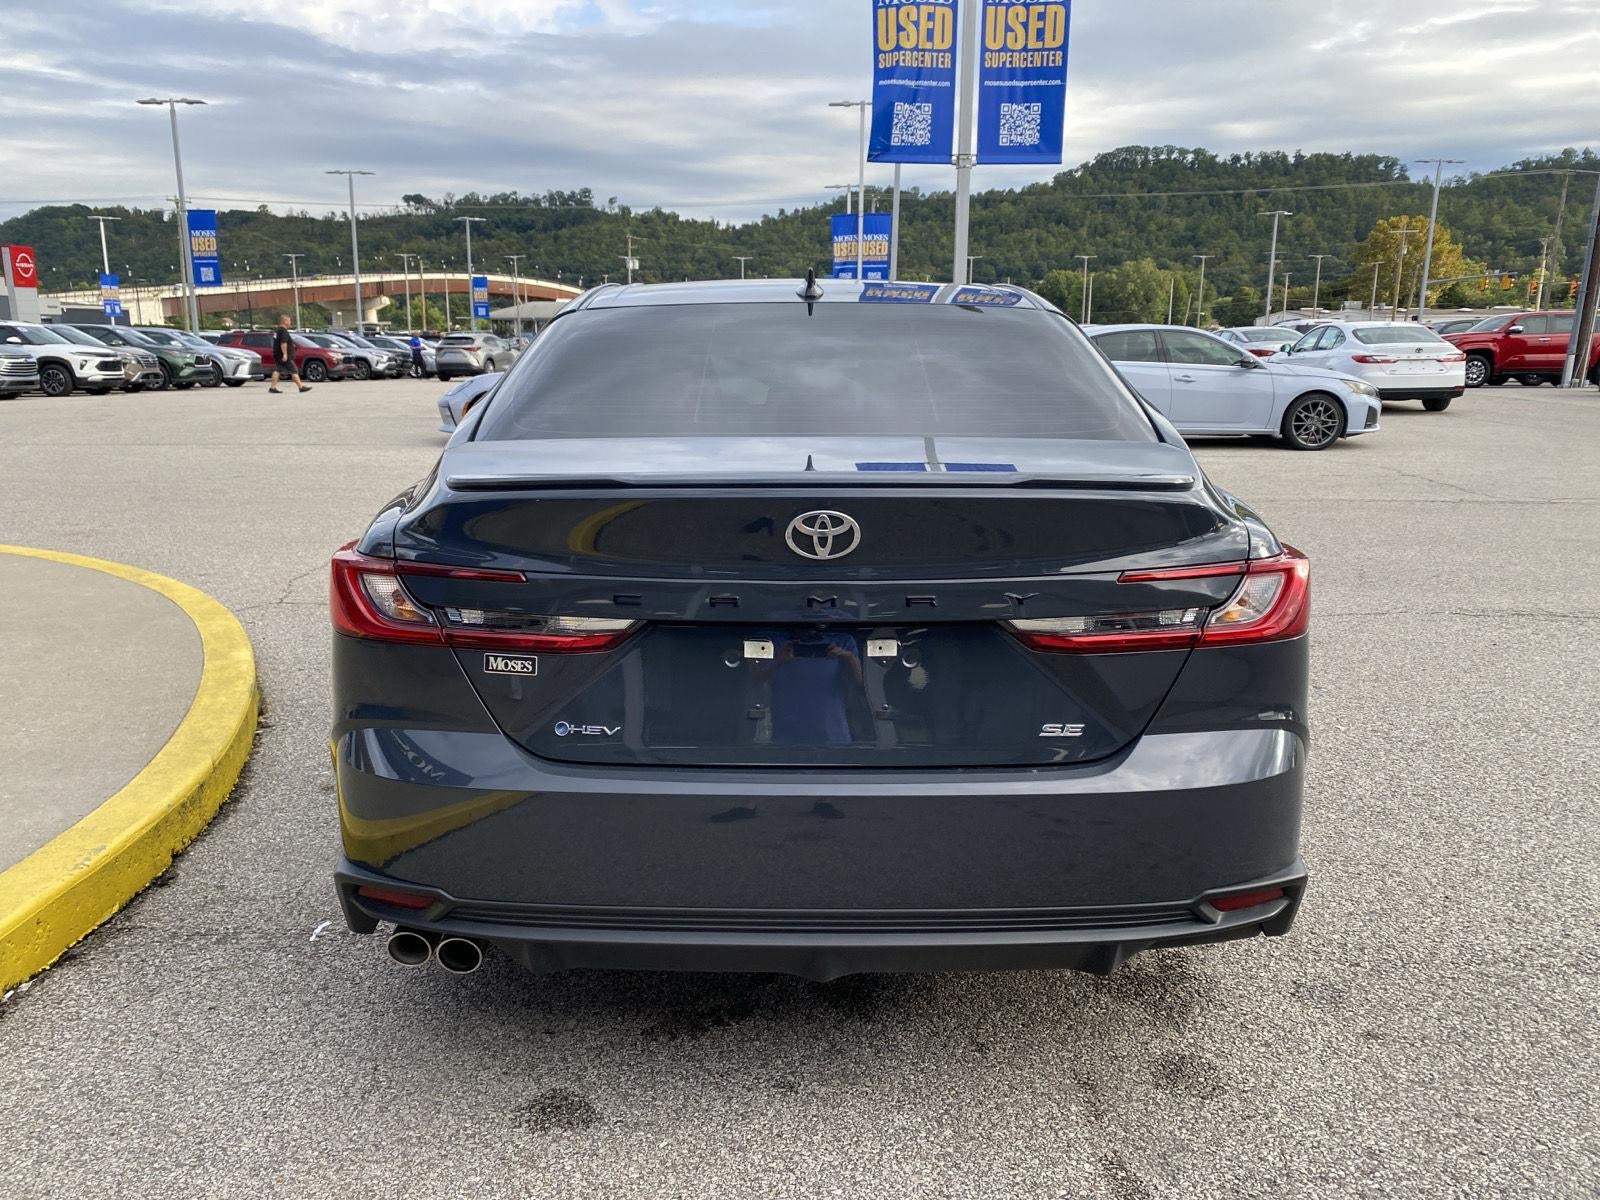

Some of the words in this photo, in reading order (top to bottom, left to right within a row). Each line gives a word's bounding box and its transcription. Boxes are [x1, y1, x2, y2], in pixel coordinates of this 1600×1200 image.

[877, 4, 953, 50] USED
[985, 4, 1066, 50] USED
[878, 50, 951, 68] SUPERCENTER
[984, 51, 1062, 68] SUPERCENTER
[191, 237, 217, 251] USED
[834, 242, 858, 256] USED
[862, 241, 888, 256] USED
[613, 592, 1040, 608] CAMRY
[1039, 723, 1085, 737] SE
